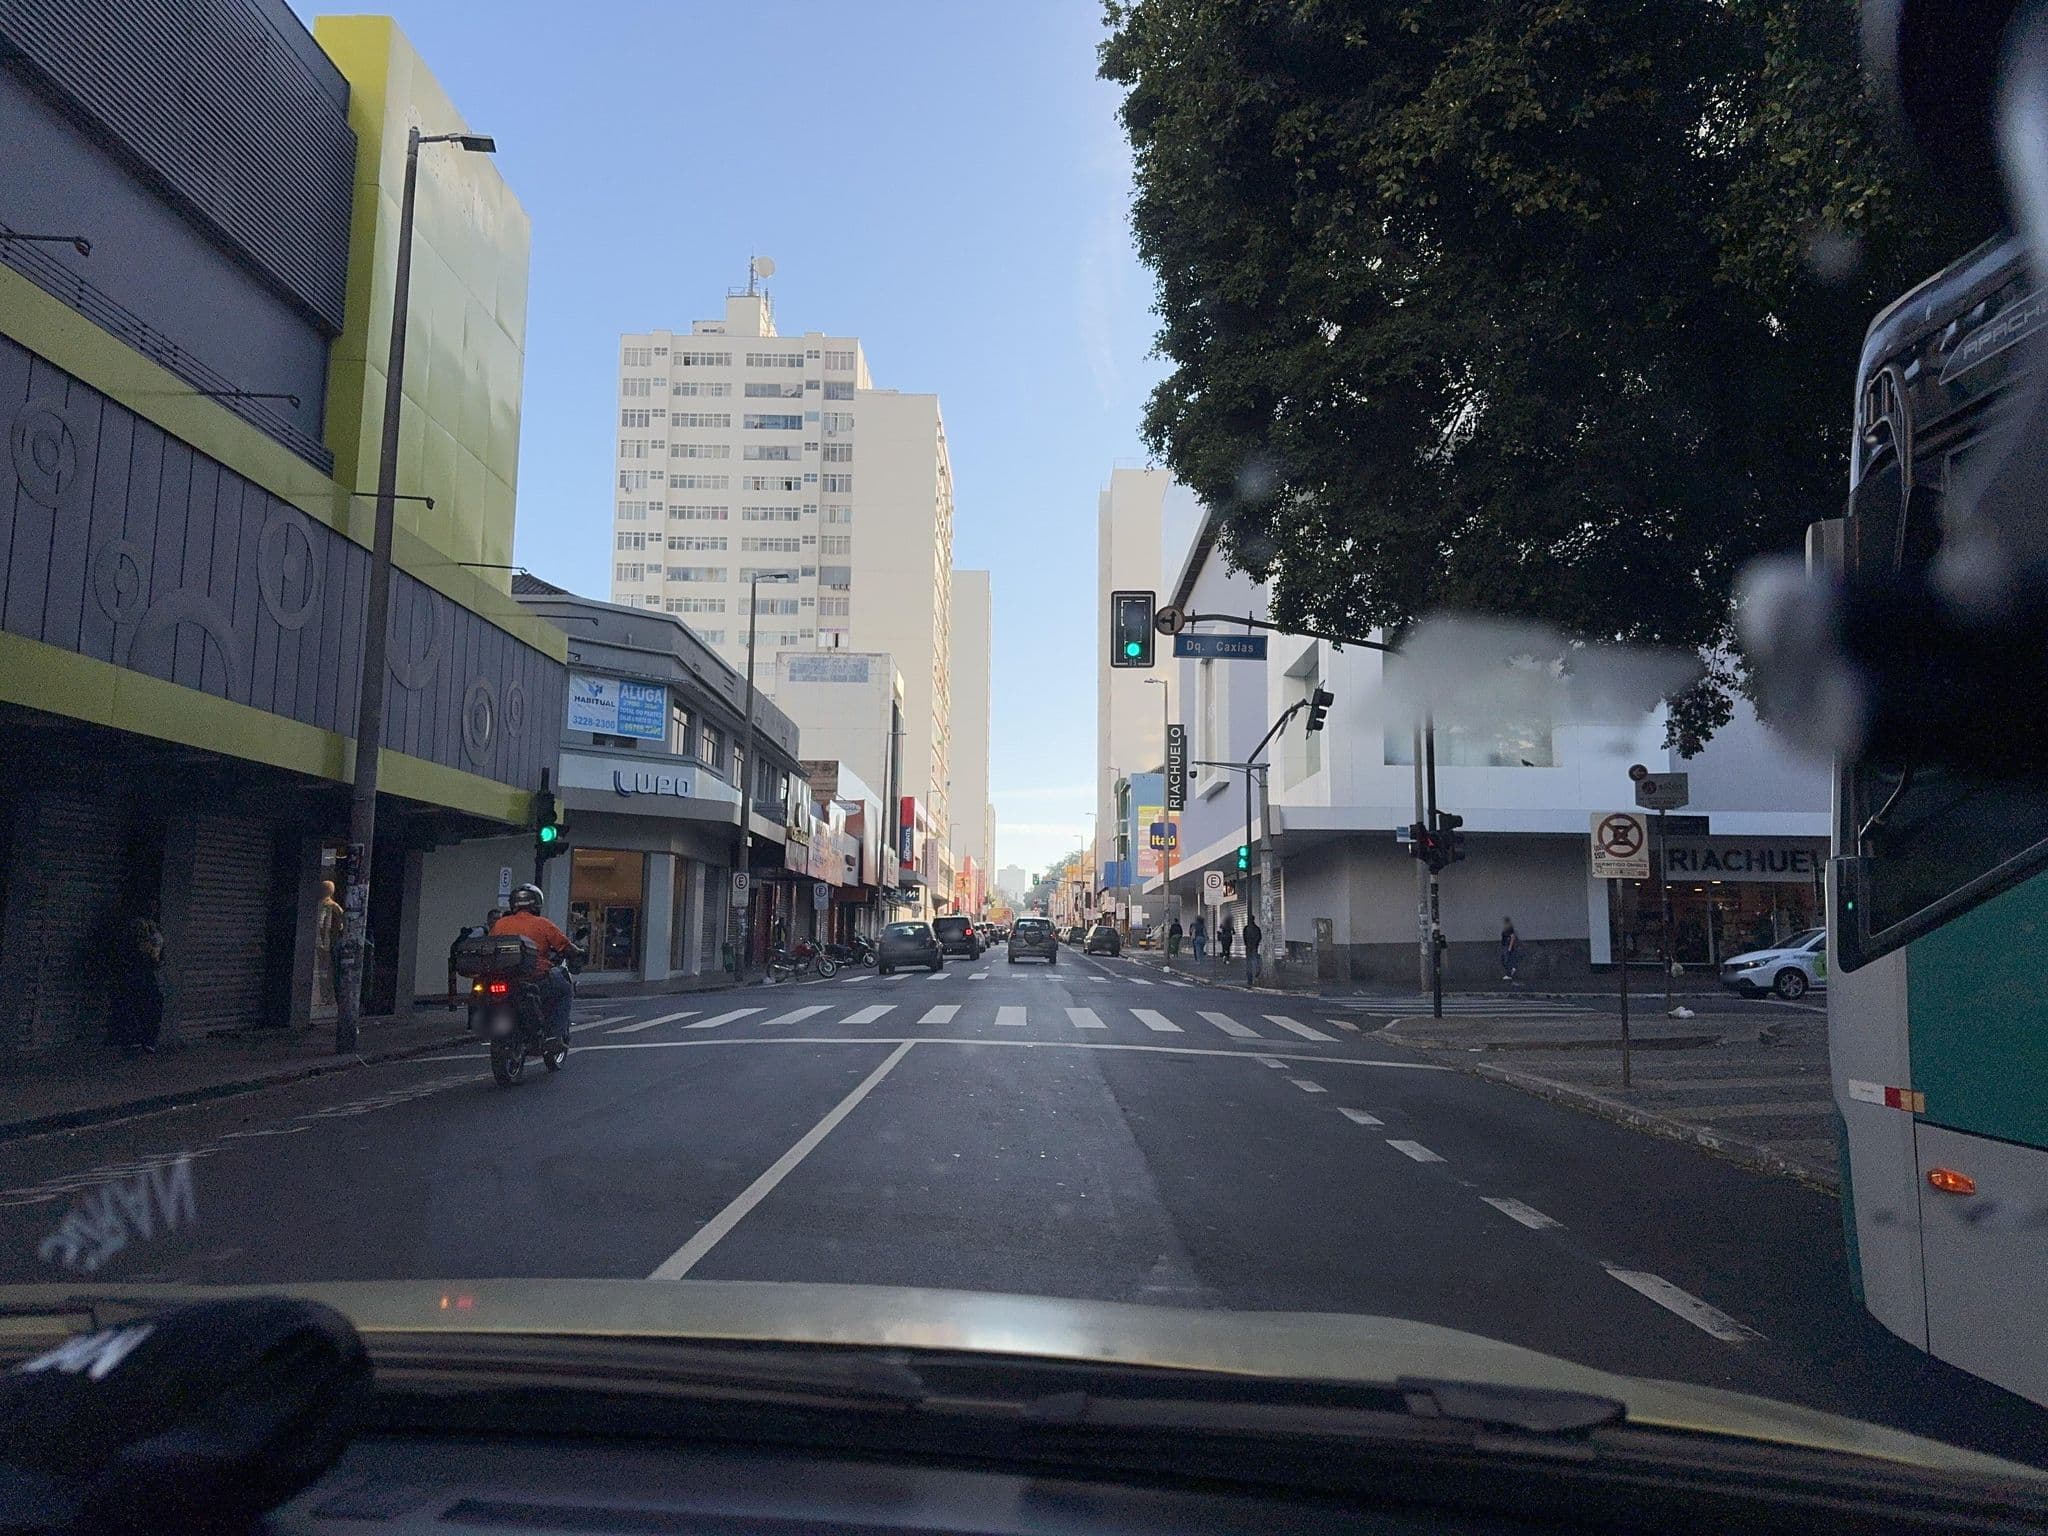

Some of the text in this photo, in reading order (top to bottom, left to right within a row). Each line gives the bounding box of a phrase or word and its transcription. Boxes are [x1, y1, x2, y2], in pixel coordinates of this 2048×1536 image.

[1216, 641, 1254, 653] Caxias
[574, 695, 615, 708] HABITUAL
[620, 685, 662, 704] ALUGA
[1169, 727, 1181, 809] RIACHUELO
[613, 769, 688, 798] LUPO
